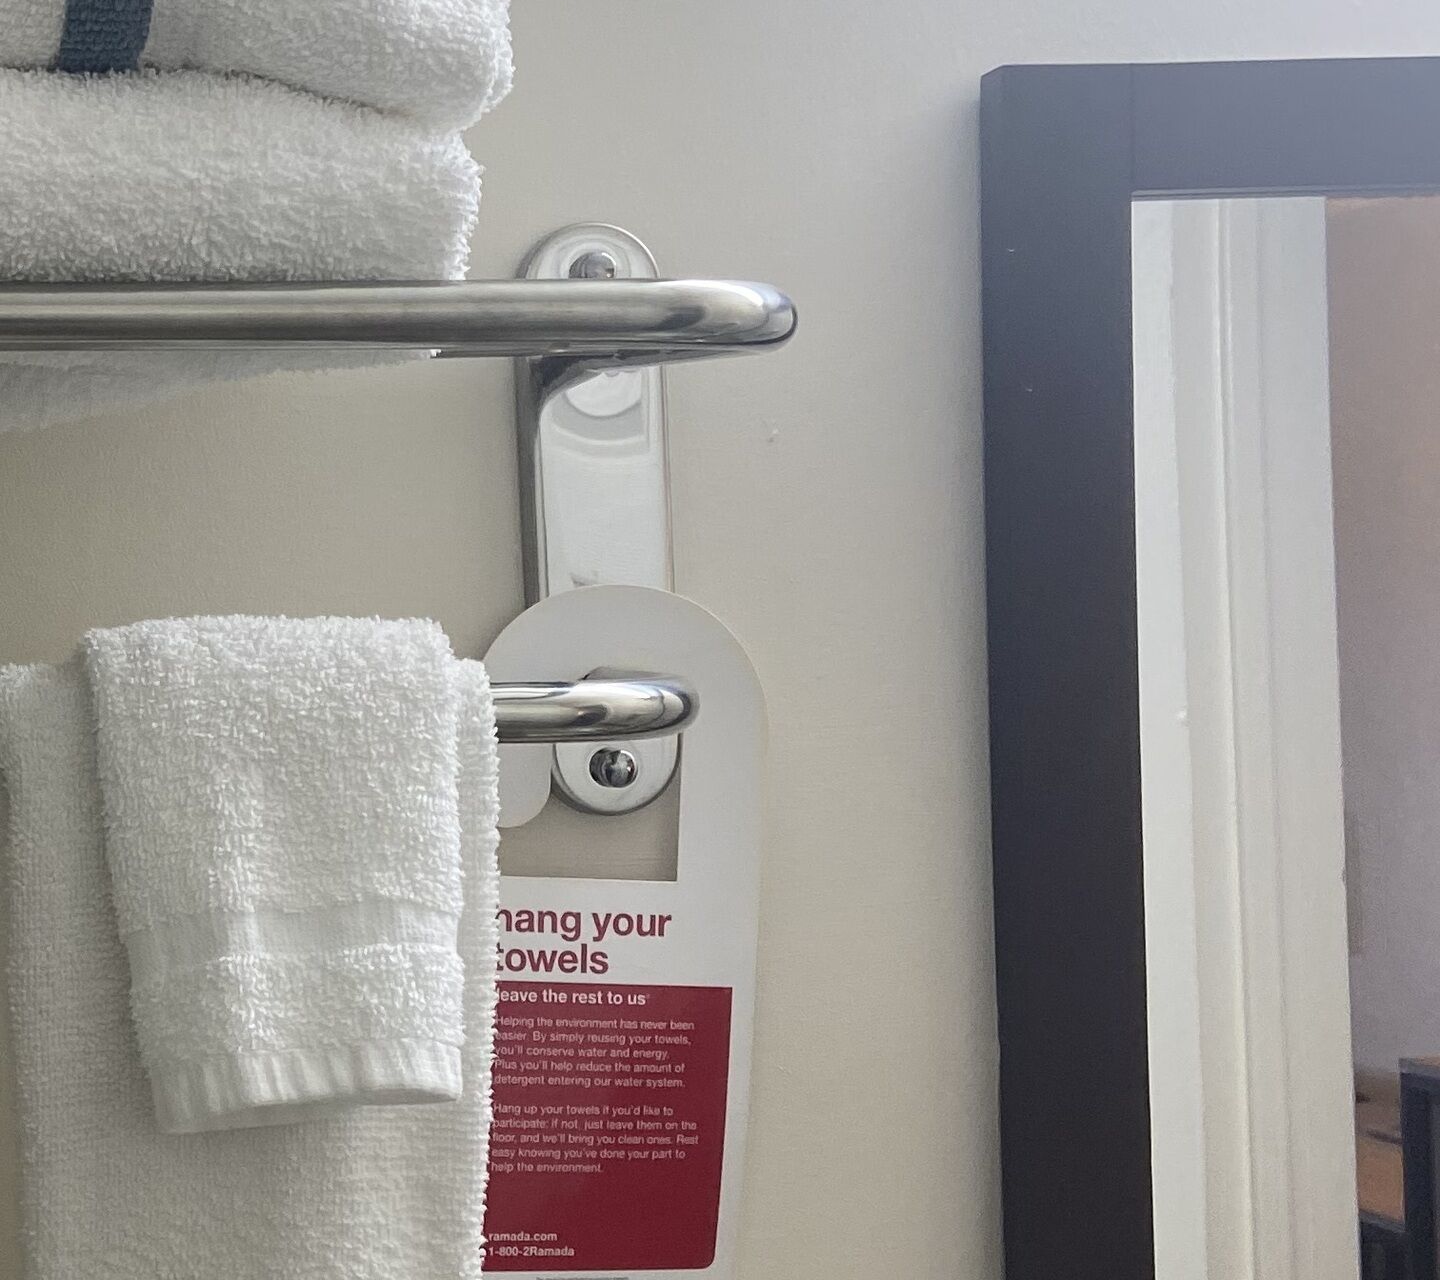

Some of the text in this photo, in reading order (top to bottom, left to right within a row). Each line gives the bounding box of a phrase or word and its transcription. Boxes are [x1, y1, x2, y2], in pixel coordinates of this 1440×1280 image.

[592, 911, 672, 942] your
[496, 943, 609, 974] towels
[542, 989, 570, 1004] the
[572, 991, 603, 1005] rest
[607, 991, 624, 1005] to
[495, 1016, 695, 1030] Helping the environment has never been
[532, 1031, 547, 1043] By
[550, 1033, 584, 1045] simply
[588, 1034, 626, 1045] reusing
[628, 1035, 652, 1045] your
[526, 1048, 574, 1057] conserve
[578, 1048, 607, 1057] water
[610, 1048, 630, 1058] and
[494, 1059, 517, 1070] Plus
[550, 1061, 573, 1072] help
[576, 1061, 612, 1072] reduce
[615, 1063, 630, 1073] the
[633, 1064, 671, 1073] amount
[675, 1064, 686, 1073] of
[494, 1074, 544, 1087] detergent
[548, 1076, 591, 1088] entering
[594, 1078, 611, 1087] our
[615, 1077, 644, 1087] water
[493, 1104, 521, 1116] Hang
[524, 1106, 537, 1116] up
[540, 1106, 564, 1116] your
[566, 1105, 600, 1115] towels
[603, 1105, 609, 1115] if
[643, 1105, 660, 1116] like
[663, 1106, 673, 1116] to
[551, 1118, 558, 1128] if
[584, 1119, 604, 1131] just
[606, 1120, 634, 1130] leave
[636, 1120, 662, 1130] them
[665, 1122, 678, 1130] on
[681, 1121, 697, 1130] the
[520, 1133, 540, 1143] and
[568, 1134, 594, 1146] bring
[596, 1136, 615, 1146] you
[618, 1134, 644, 1144] clean
[676, 1134, 699, 1145] Rest
[491, 1149, 516, 1159] easy
[518, 1148, 561, 1160] knowing
[600, 1149, 625, 1159] done
[627, 1150, 650, 1160] your
[652, 1149, 673, 1160] part
[675, 1149, 686, 1159] to
[491, 1162, 514, 1174] help
[517, 1162, 534, 1172] the
[488, 1231, 558, 1241] ramada.com
[488, 1246, 575, 1257] 1-800-2Ramada
